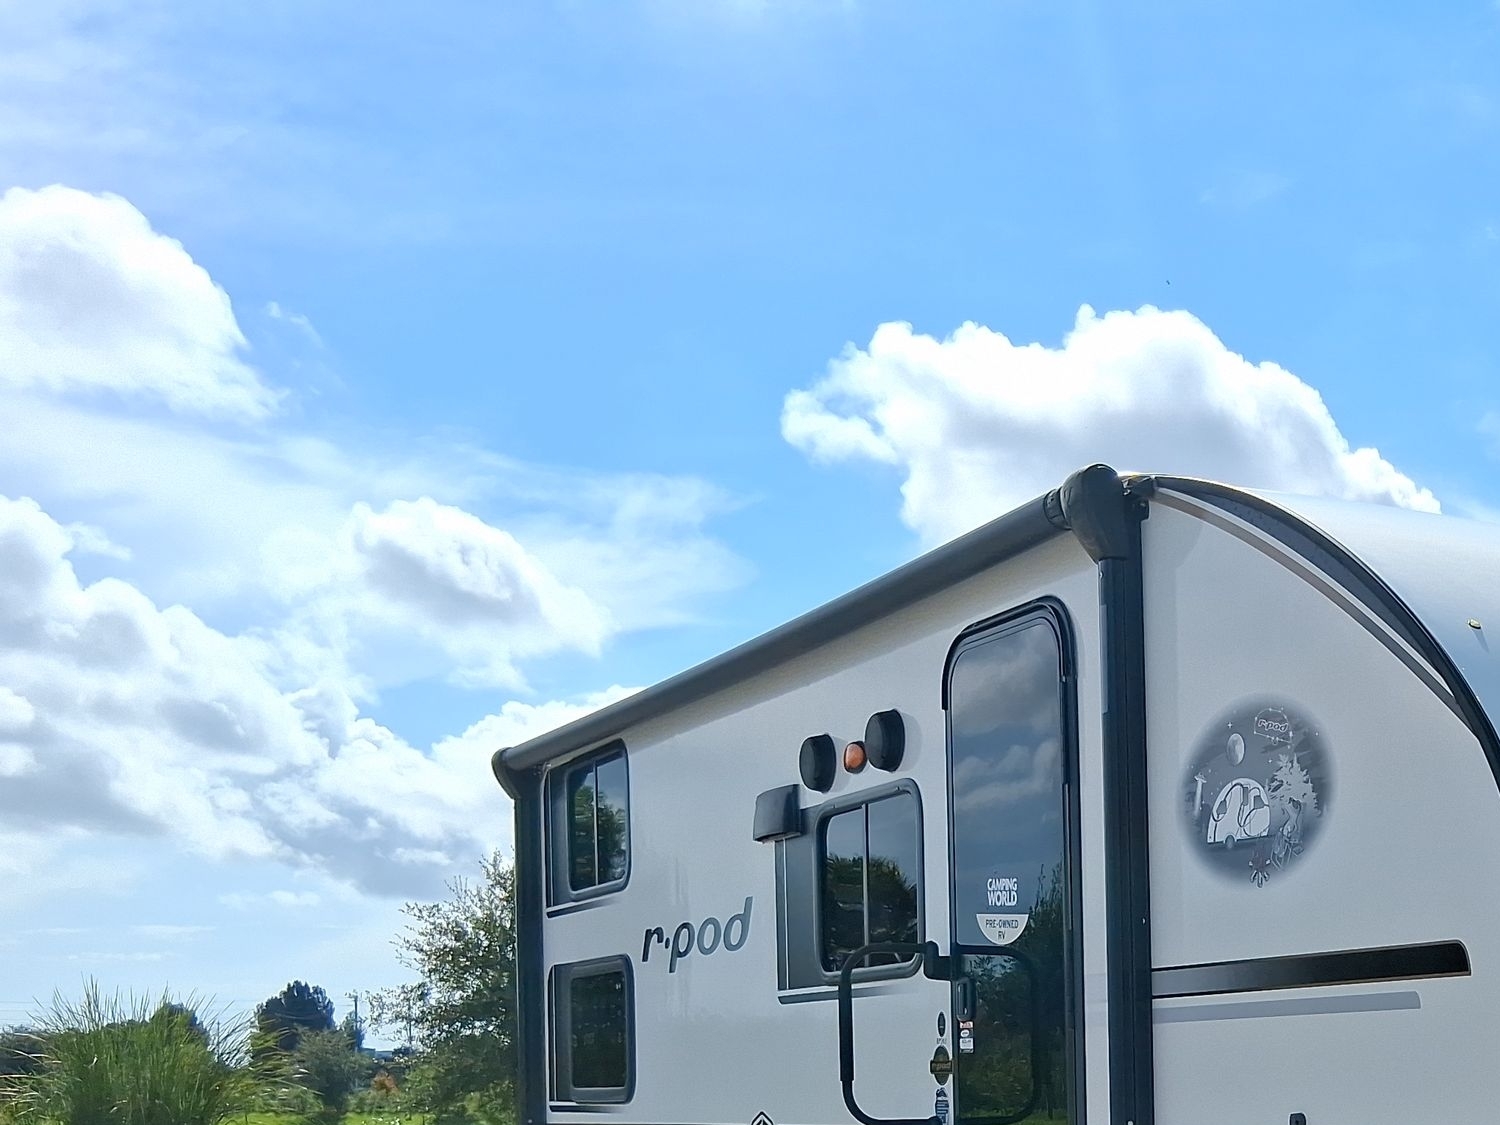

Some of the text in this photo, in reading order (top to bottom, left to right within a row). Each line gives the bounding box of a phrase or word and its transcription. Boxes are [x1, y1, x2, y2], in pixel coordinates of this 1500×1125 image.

[987, 878, 1018, 891] CAMPING
[987, 890, 1018, 907] WORLD
[985, 919, 1019, 929] PRE-OWNED
[997, 931, 1006, 940] RV
